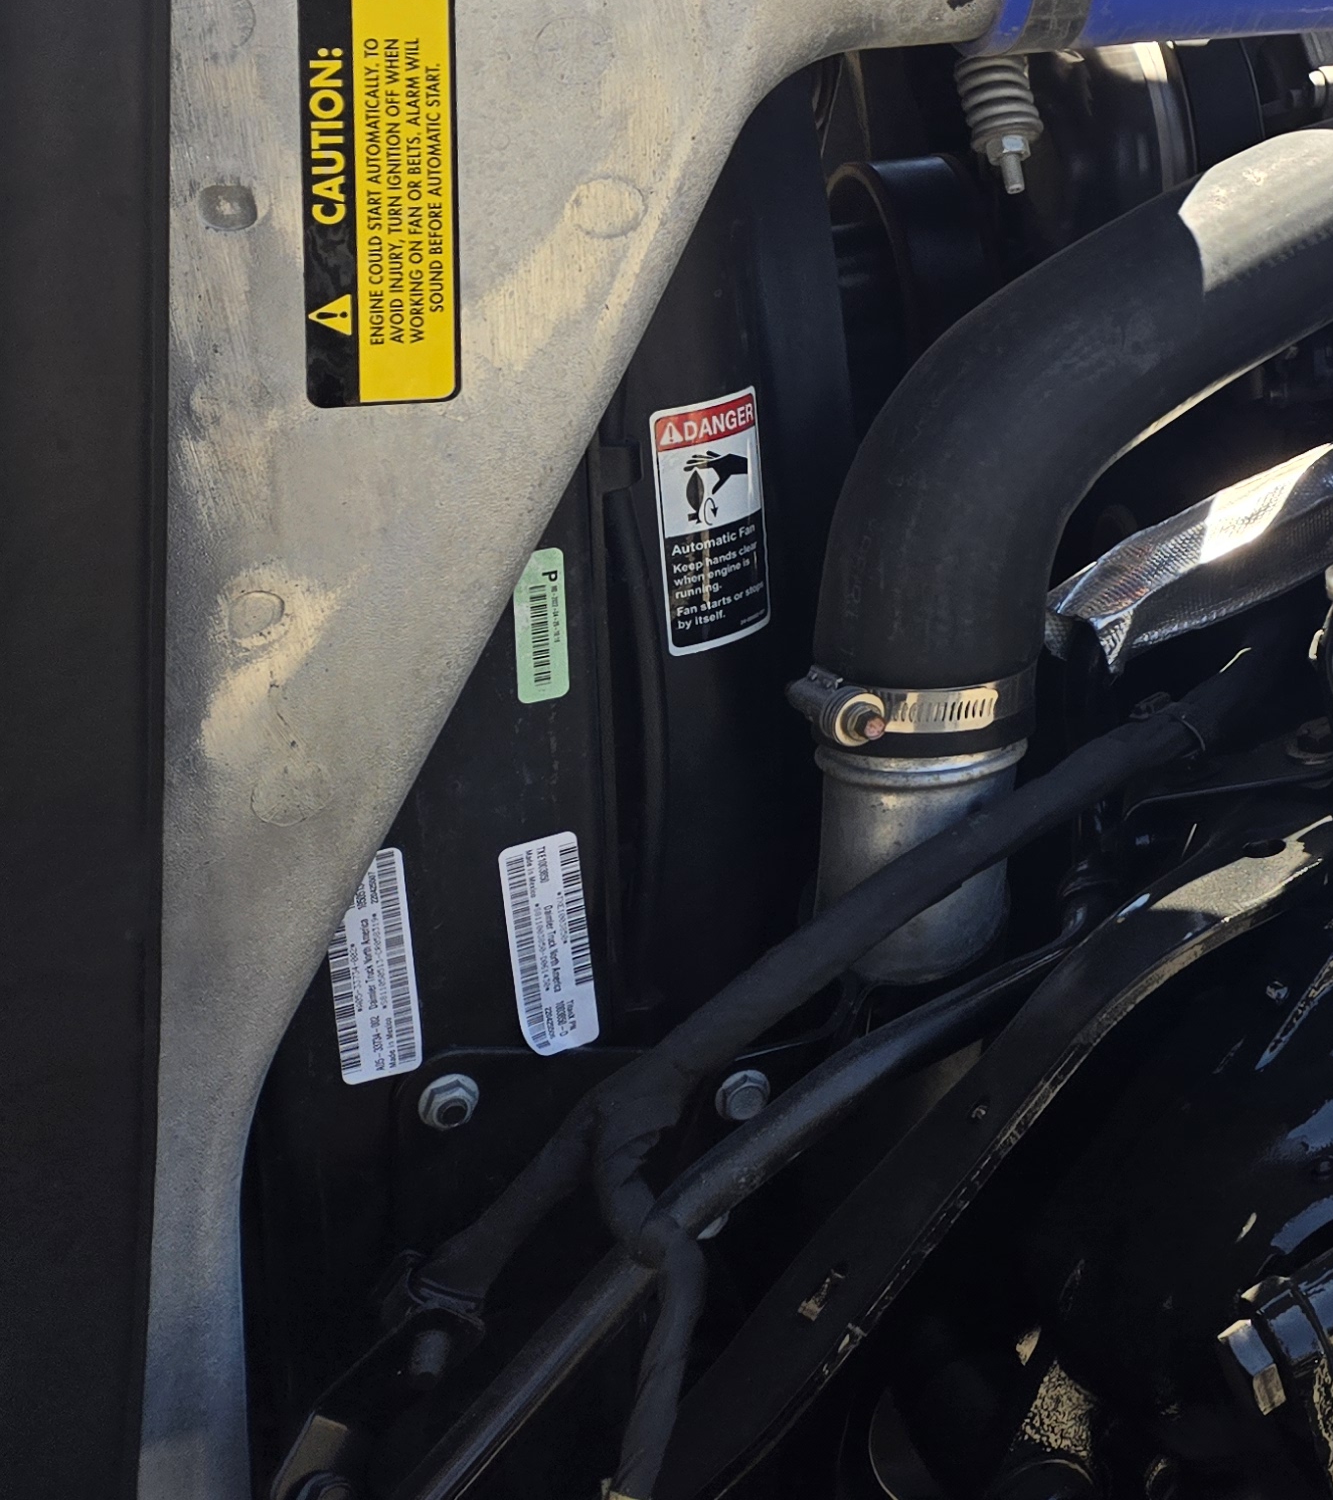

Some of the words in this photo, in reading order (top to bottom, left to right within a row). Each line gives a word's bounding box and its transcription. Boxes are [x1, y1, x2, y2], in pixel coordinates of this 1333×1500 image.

[364, 37, 379, 57] TO
[385, 38, 400, 89] WHEN
[405, 37, 420, 76] WILL
[385, 90, 400, 118] OFF
[406, 77, 421, 126] ALARM
[426, 63, 442, 112] START.
[309, 46, 347, 225] CAUTION:
[365, 62, 382, 186] AUTOMATICALLY.
[386, 123, 402, 191] IGNITION
[406, 133, 422, 176] BELTS.
[427, 114, 443, 195] AUTOMATIC
[407, 180, 422, 200] OR
[367, 189, 382, 232] START
[387, 196, 403, 235] TURN
[408, 203, 424, 236] FAN
[429, 202, 443, 258] BEFORE
[369, 236, 384, 285] COULD
[388, 238, 407, 296] INJURY,
[409, 239, 424, 263] ON
[430, 260, 445, 312] SOUND
[369, 292, 385, 346] ENGINE
[389, 297, 406, 344] AVOID
[410, 268, 425, 344] WORKING
[683, 402, 754, 442] DANGER
[671, 531, 737, 557] Automatic
[739, 524, 756, 537] Fan
[673, 559, 703, 574] Keep
[705, 549, 737, 566] hands
[739, 541, 757, 557] clear
[674, 573, 705, 587] when
[707, 562, 741, 580] engine
[742, 558, 750, 567] is
[542, 570, 558, 582] P
[675, 582, 722, 600] running.
[676, 604, 697, 617] Fan
[700, 596, 731, 612] starts
[733, 590, 743, 601] or
[744, 580, 764, 597] stops
[678, 618, 692, 630] by
[694, 611, 726, 626] itself.
[524, 849, 532, 867] Made
[526, 867, 533, 877] in
[528, 877, 536, 898] Mexico
[360, 919, 370, 944] America
[543, 904, 554, 929] Daimler
[363, 947, 373, 963] North
[546, 930, 556, 947] Truck
[365, 965, 375, 982] Truck
[548, 948, 558, 966] North
[550, 966, 561, 992] America
[366, 984, 377, 1009] Daimler
[385, 1017, 393, 1039] Mexico
[388, 1050, 396, 1067] Made
